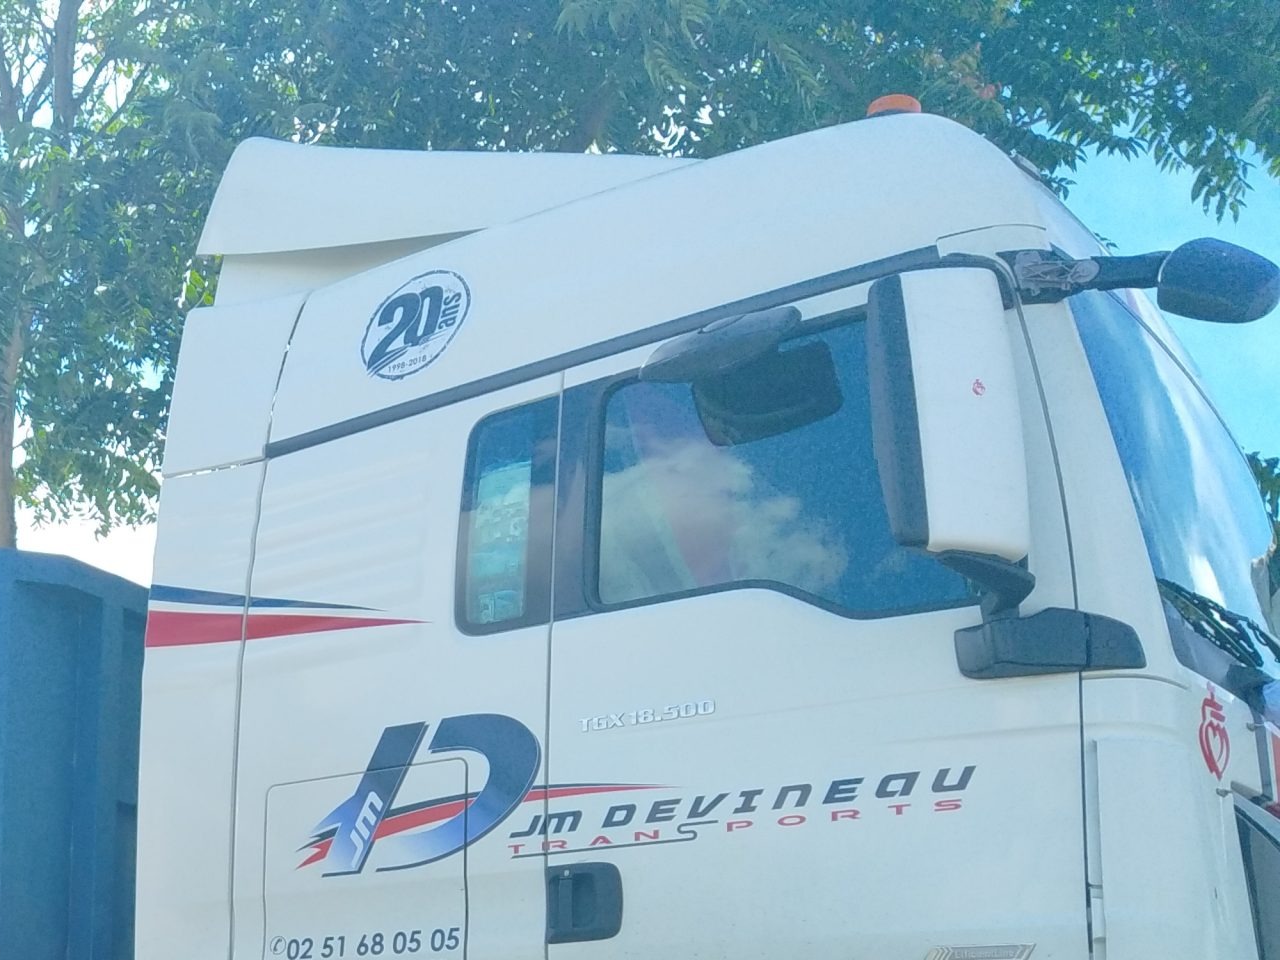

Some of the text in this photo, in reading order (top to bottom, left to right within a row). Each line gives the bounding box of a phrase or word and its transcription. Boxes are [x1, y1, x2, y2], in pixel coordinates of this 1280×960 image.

[367, 286, 462, 371] 20 ans
[387, 355, 428, 373] 1998-2018
[579, 699, 716, 733] TGX 18.500
[508, 799, 962, 857] TRANSPORTS
[286, 927, 461, 960] 02 51 68 05 05
